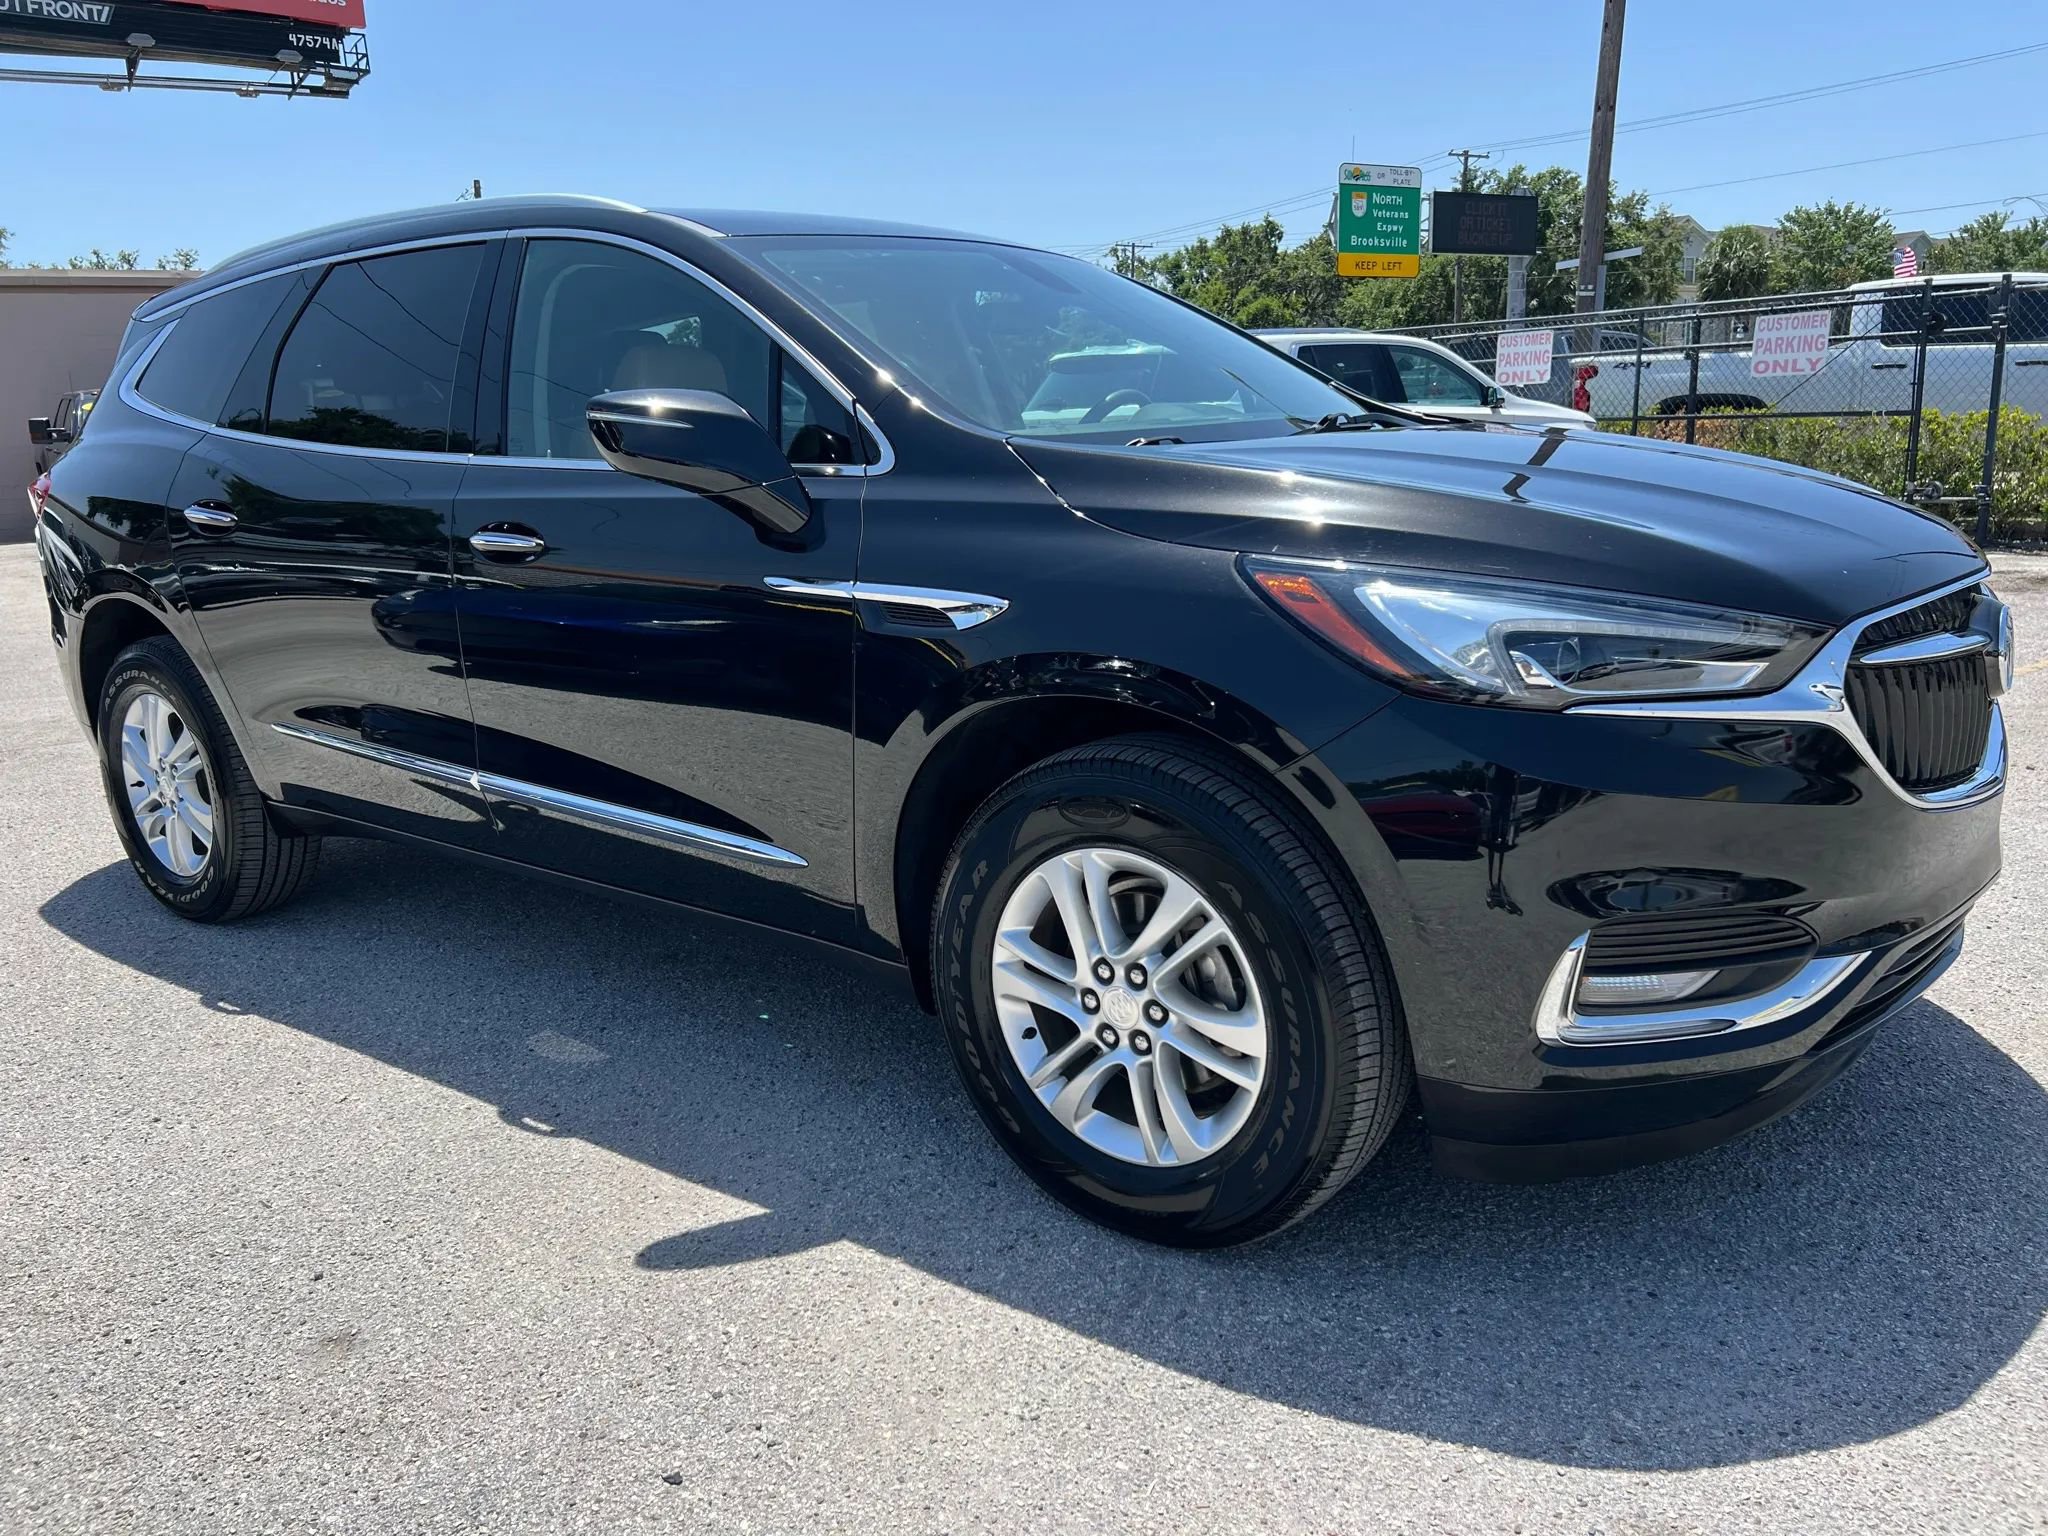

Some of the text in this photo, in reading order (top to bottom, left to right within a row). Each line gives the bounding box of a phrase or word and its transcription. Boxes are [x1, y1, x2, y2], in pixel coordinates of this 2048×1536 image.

[1393, 178, 1412, 186] PLATE
[1372, 192, 1403, 206] NORTH
[1372, 209, 1409, 219] Veterans
[1377, 222, 1404, 234] Expwy
[1351, 235, 1408, 248] Brooksville
[1355, 261, 1403, 271] KEEP LEFT
[1758, 313, 1828, 332] CUSTOMER
[1500, 332, 1552, 348] CUSTOMER
[1755, 334, 1826, 355] PARKING
[1498, 349, 1550, 368] PARKING
[1753, 357, 1824, 374] ONLY
[1498, 369, 1549, 383] ONLY
[951, 859, 1021, 1134] GOODYEAR
[1215, 880, 1301, 1178] ASSURANCE
